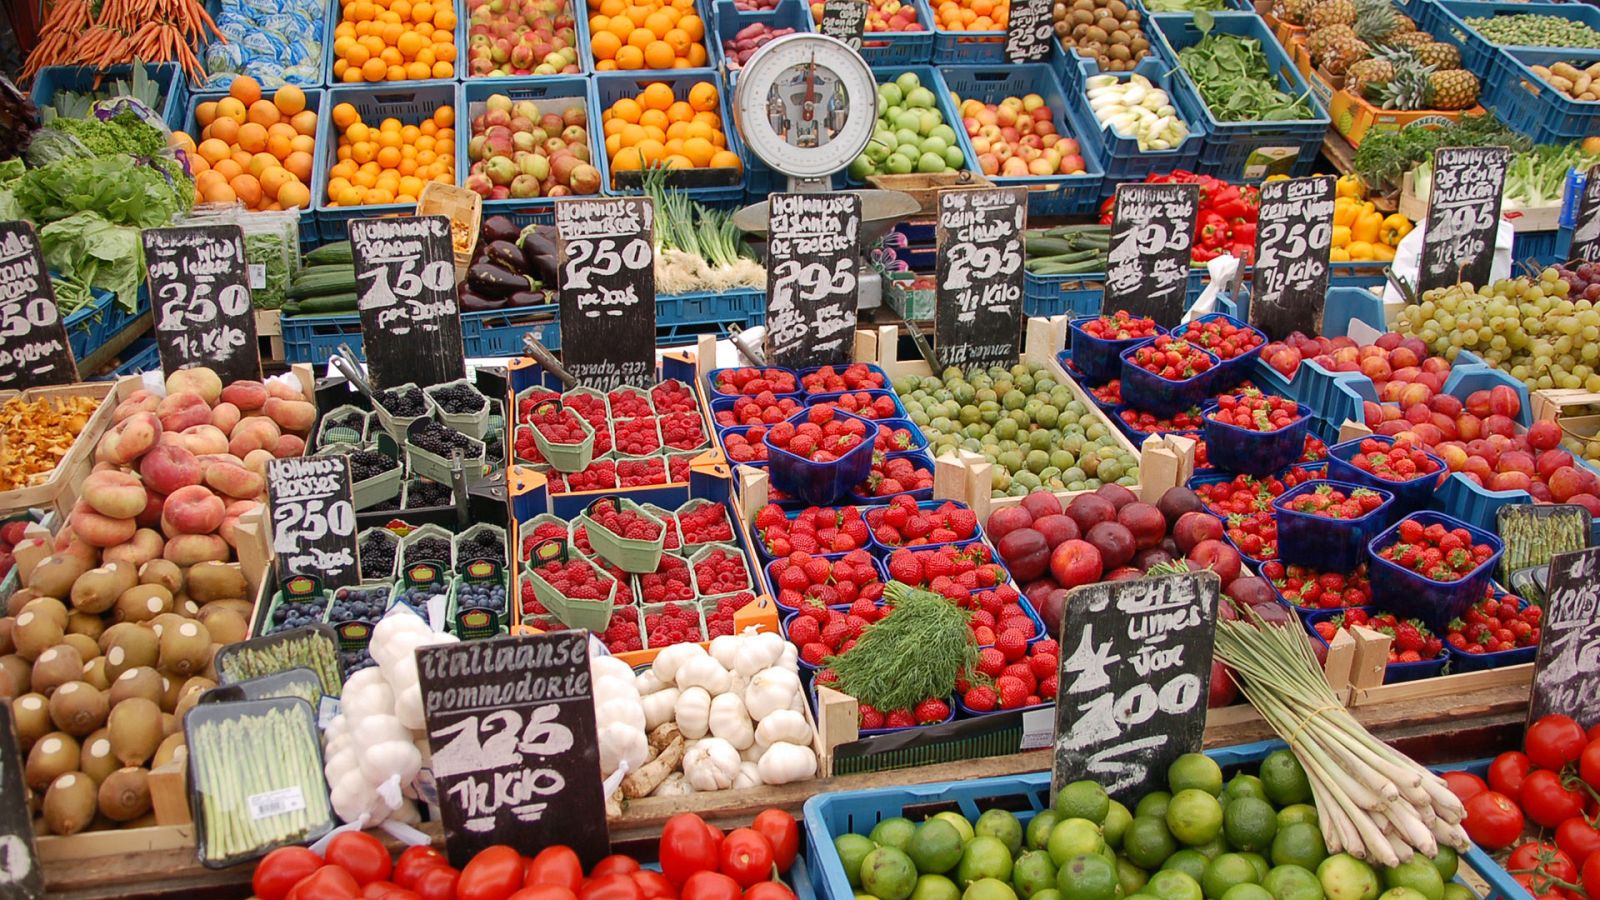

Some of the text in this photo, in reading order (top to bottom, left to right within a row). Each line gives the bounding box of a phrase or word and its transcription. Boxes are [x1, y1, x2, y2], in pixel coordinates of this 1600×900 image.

[1006, 25, 1051, 52] 250
[562, 238, 651, 290] 250
[942, 239, 1022, 290] 295
[1108, 223, 1189, 263] 195
[1257, 222, 1332, 268] 250
[158, 282, 250, 331] 250
[357, 258, 455, 310] 150
[768, 258, 855, 311] 295
[274, 500, 354, 553] 250
[420, 637, 587, 680] italiaanse
[427, 667, 589, 717] pommodorie
[1057, 673, 1200, 750] 100
[431, 703, 574, 778] 125
